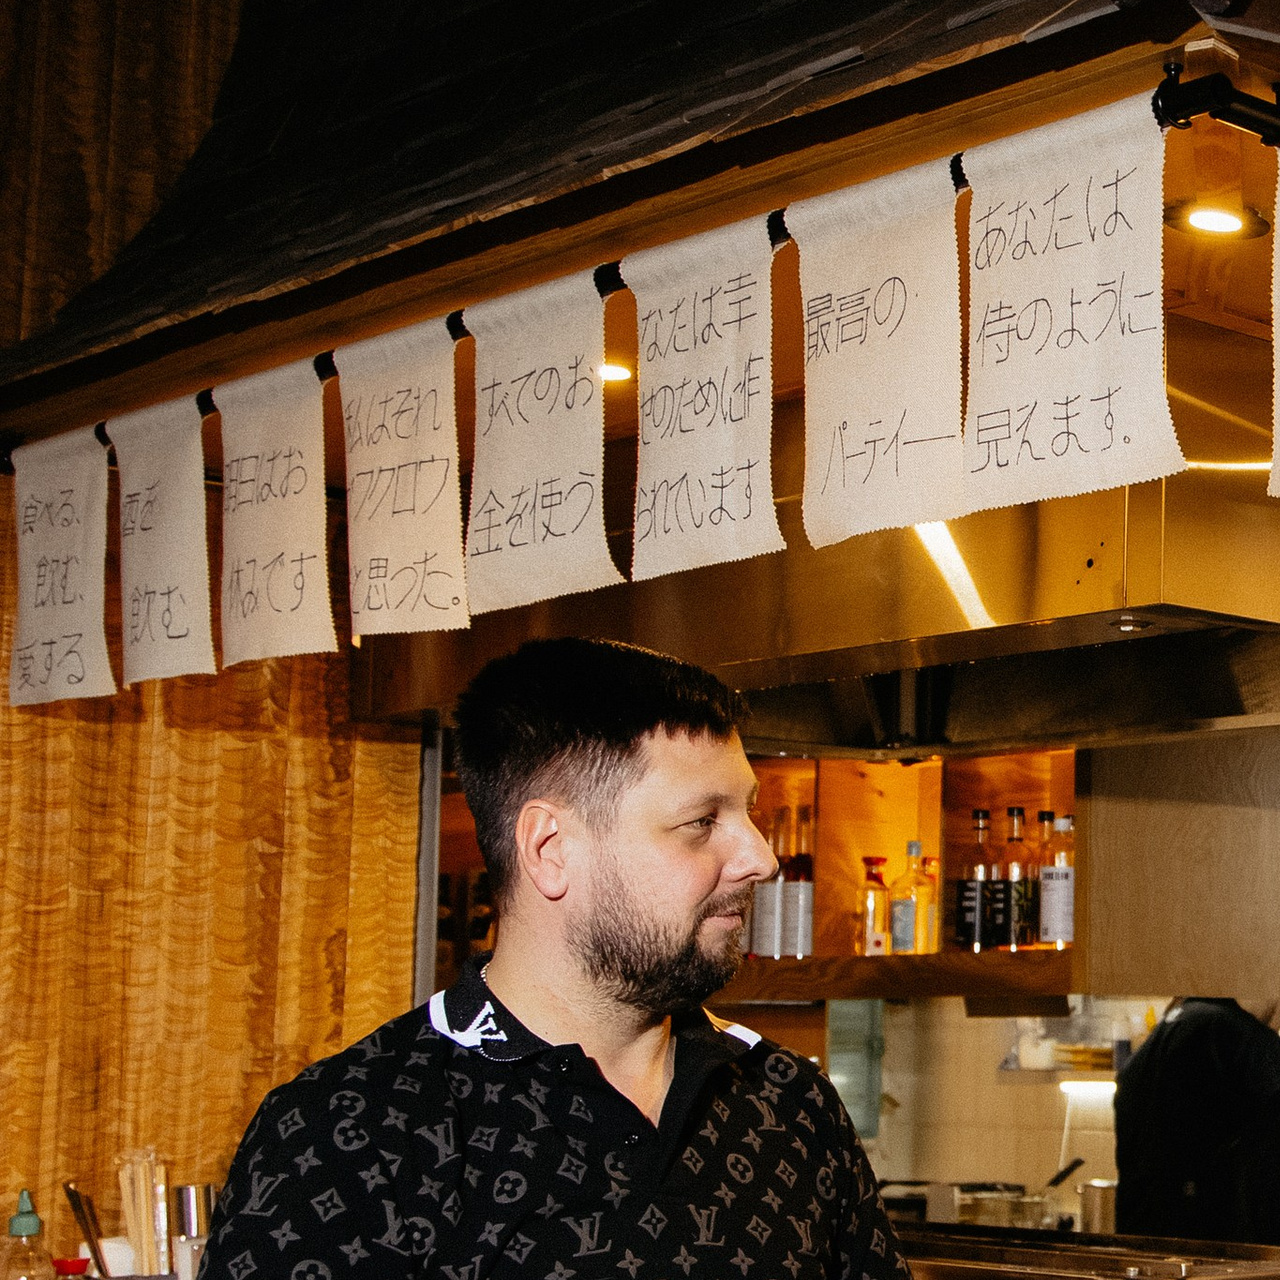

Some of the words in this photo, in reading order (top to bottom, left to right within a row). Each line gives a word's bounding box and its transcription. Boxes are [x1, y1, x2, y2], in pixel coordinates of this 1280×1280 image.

[974, 166, 1138, 271] あなたは
[804, 276, 909, 364] 最高の
[975, 270, 1158, 368] 侍のように
[480, 353, 596, 437] すべてのお
[970, 386, 1132, 474] 見えます。
[469, 470, 596, 558] 金を使う
[636, 458, 760, 542] られています
